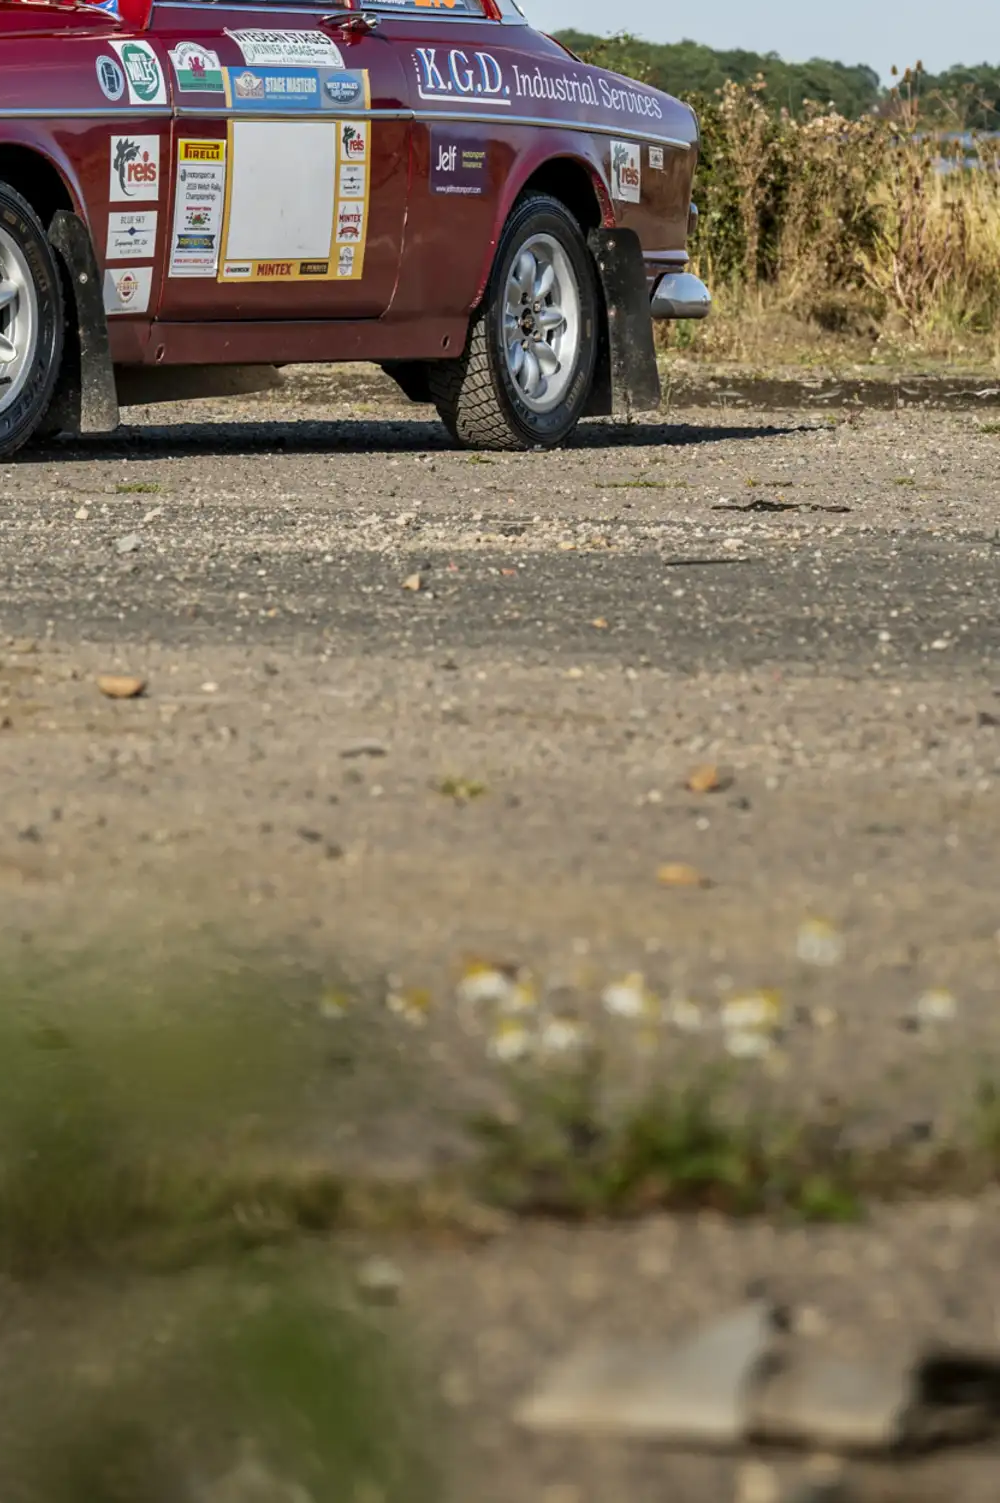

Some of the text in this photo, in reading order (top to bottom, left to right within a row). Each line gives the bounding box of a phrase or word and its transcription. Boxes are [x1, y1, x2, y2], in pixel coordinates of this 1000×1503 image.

[285, 32, 332, 45] STAGES
[416, 48, 663, 119] K.G.D. Industrial Services
[184, 143, 220, 159] PIRELLI
[350, 133, 364, 152] reis
[128, 150, 156, 182] reis
[436, 145, 457, 172] Jelf
[339, 214, 361, 223] MINTEX
[257, 263, 293, 276] MINTEX
